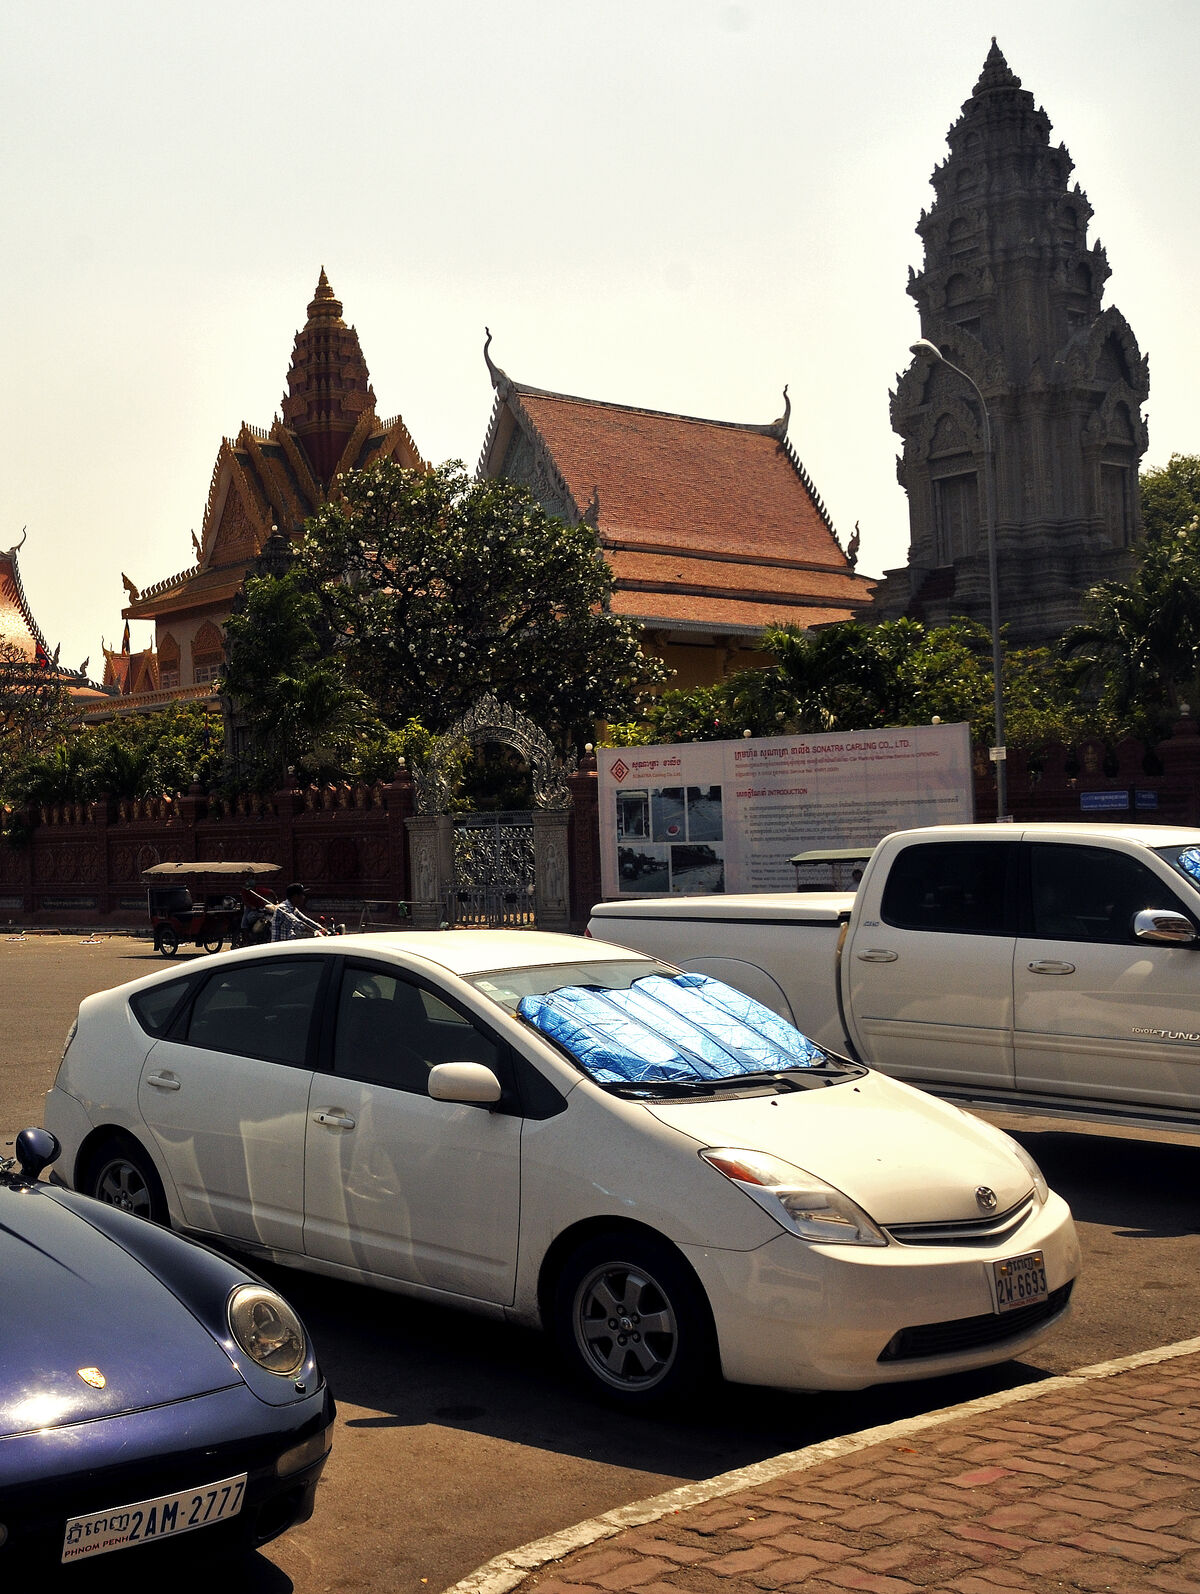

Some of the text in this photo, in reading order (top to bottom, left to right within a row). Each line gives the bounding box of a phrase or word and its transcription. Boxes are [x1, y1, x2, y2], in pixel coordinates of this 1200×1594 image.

[812, 744, 844, 754] SONATRA
[846, 742, 877, 751] CARLING
[768, 788, 808, 796] INTRODUCTION
[66, 1514, 130, 1544] ភ្នំពេញ
[64, 1536, 129, 1558] PHNOM PENH
